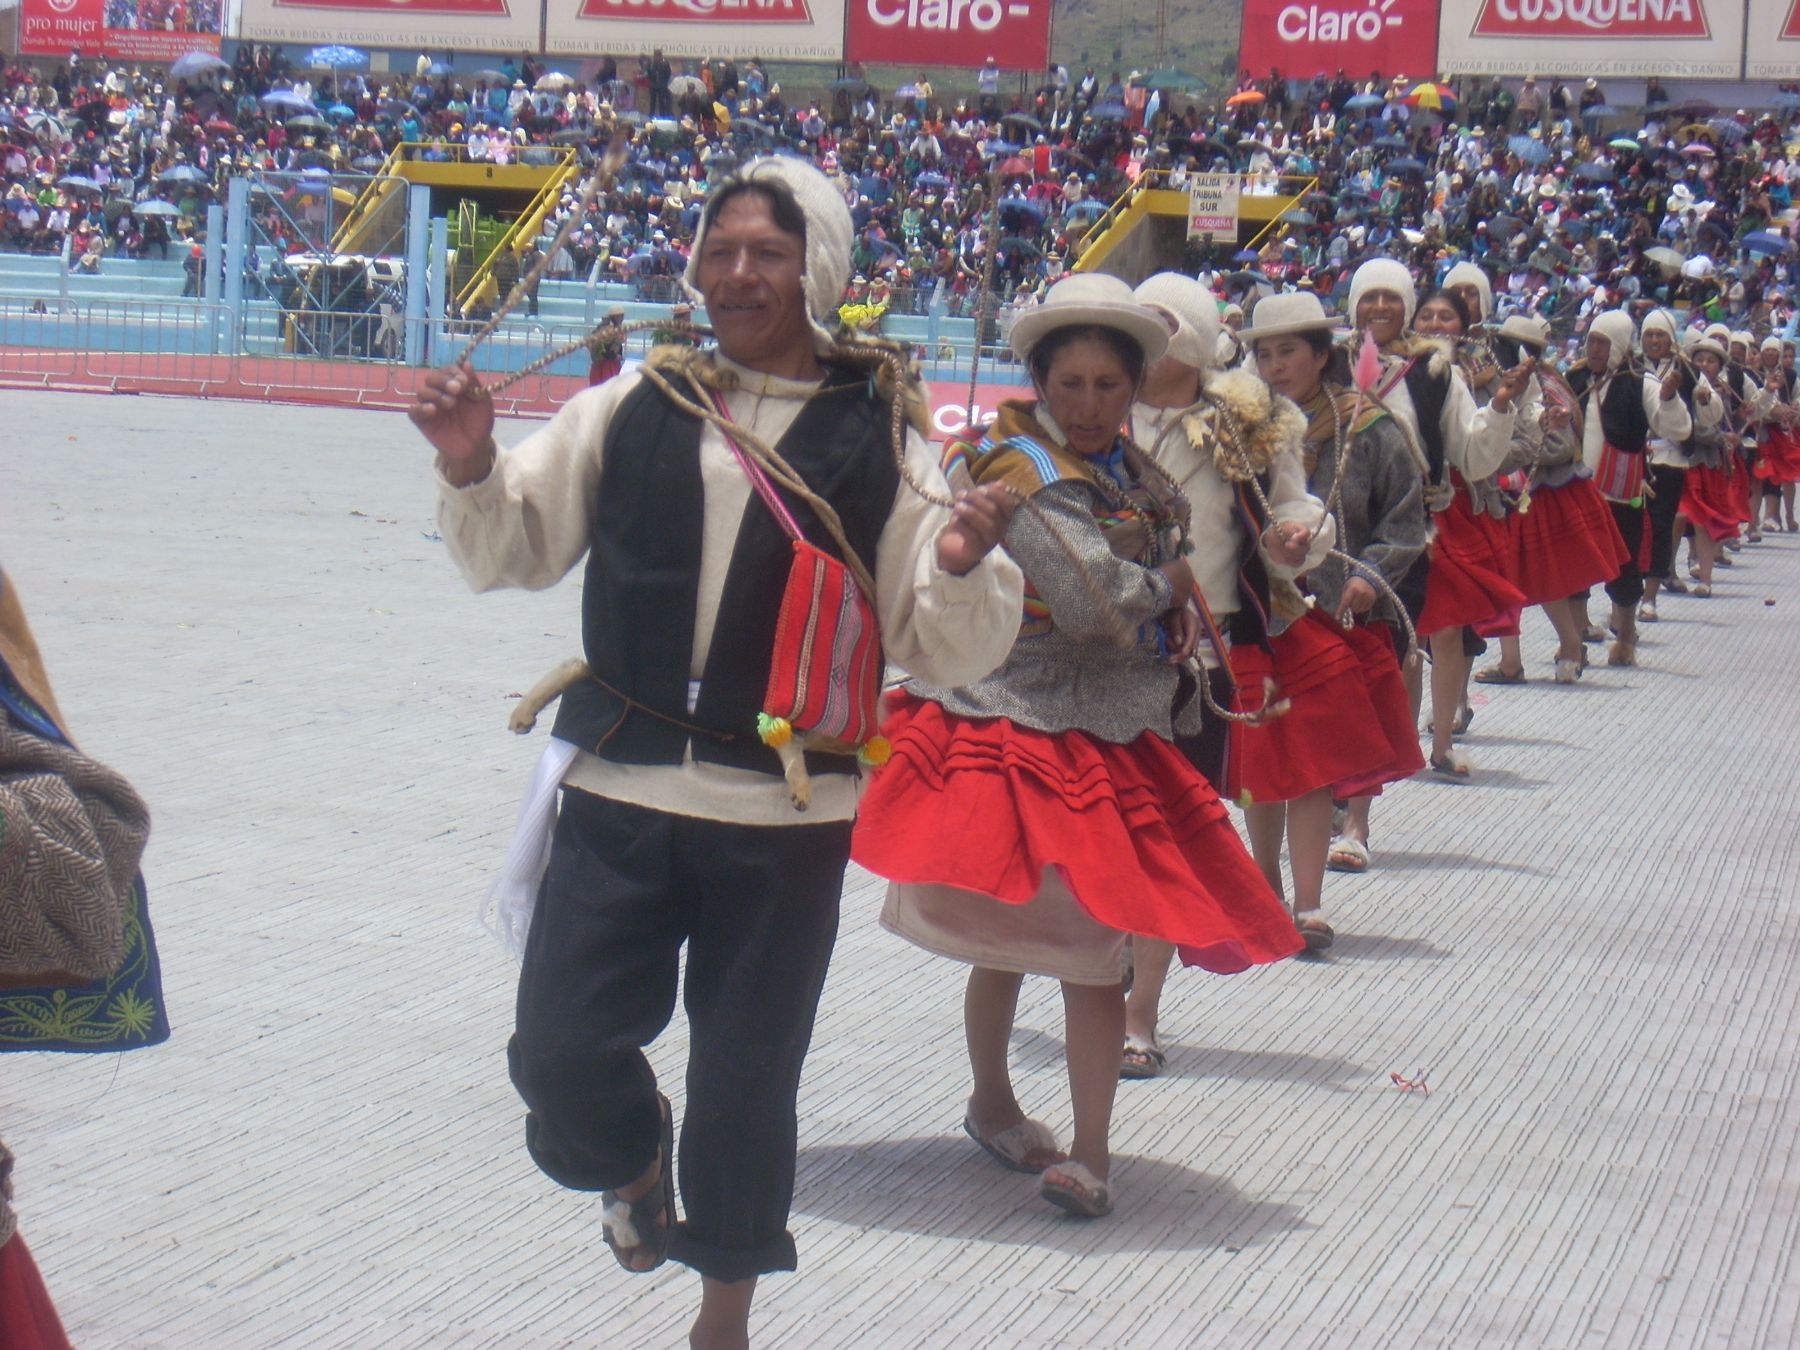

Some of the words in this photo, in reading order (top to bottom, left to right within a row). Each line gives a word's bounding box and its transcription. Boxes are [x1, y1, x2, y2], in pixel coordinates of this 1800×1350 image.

[867, 0, 1002, 31] Claro
[26, 17, 50, 35] pro
[56, 16, 98, 37] mujer
[1277, 5, 1382, 42] Claro
[249, 27, 285, 37] TOMAR
[290, 30, 333, 40] BEBIDAS
[414, 34, 427, 44] EN
[431, 35, 472, 46] EXCESO
[476, 37, 487, 47] ES
[553, 40, 589, 50] TOMAR
[594, 41, 637, 52] BEBIDAS
[717, 45, 730, 55] EN
[734, 45, 774, 55] EXCESO
[779, 46, 790, 56] ES
[1445, 61, 1483, 71] TOMAR
[1486, 61, 1530, 72] BEBIDAS
[1613, 63, 1626, 73] EN
[1630, 63, 1672, 73] EXCESO
[1754, 65, 1792, 75] TOMAR
[1196, 177, 1221, 187] SALIDA
[1193, 189, 1222, 199] TRIBUNA
[1199, 202, 1218, 212] SUR
